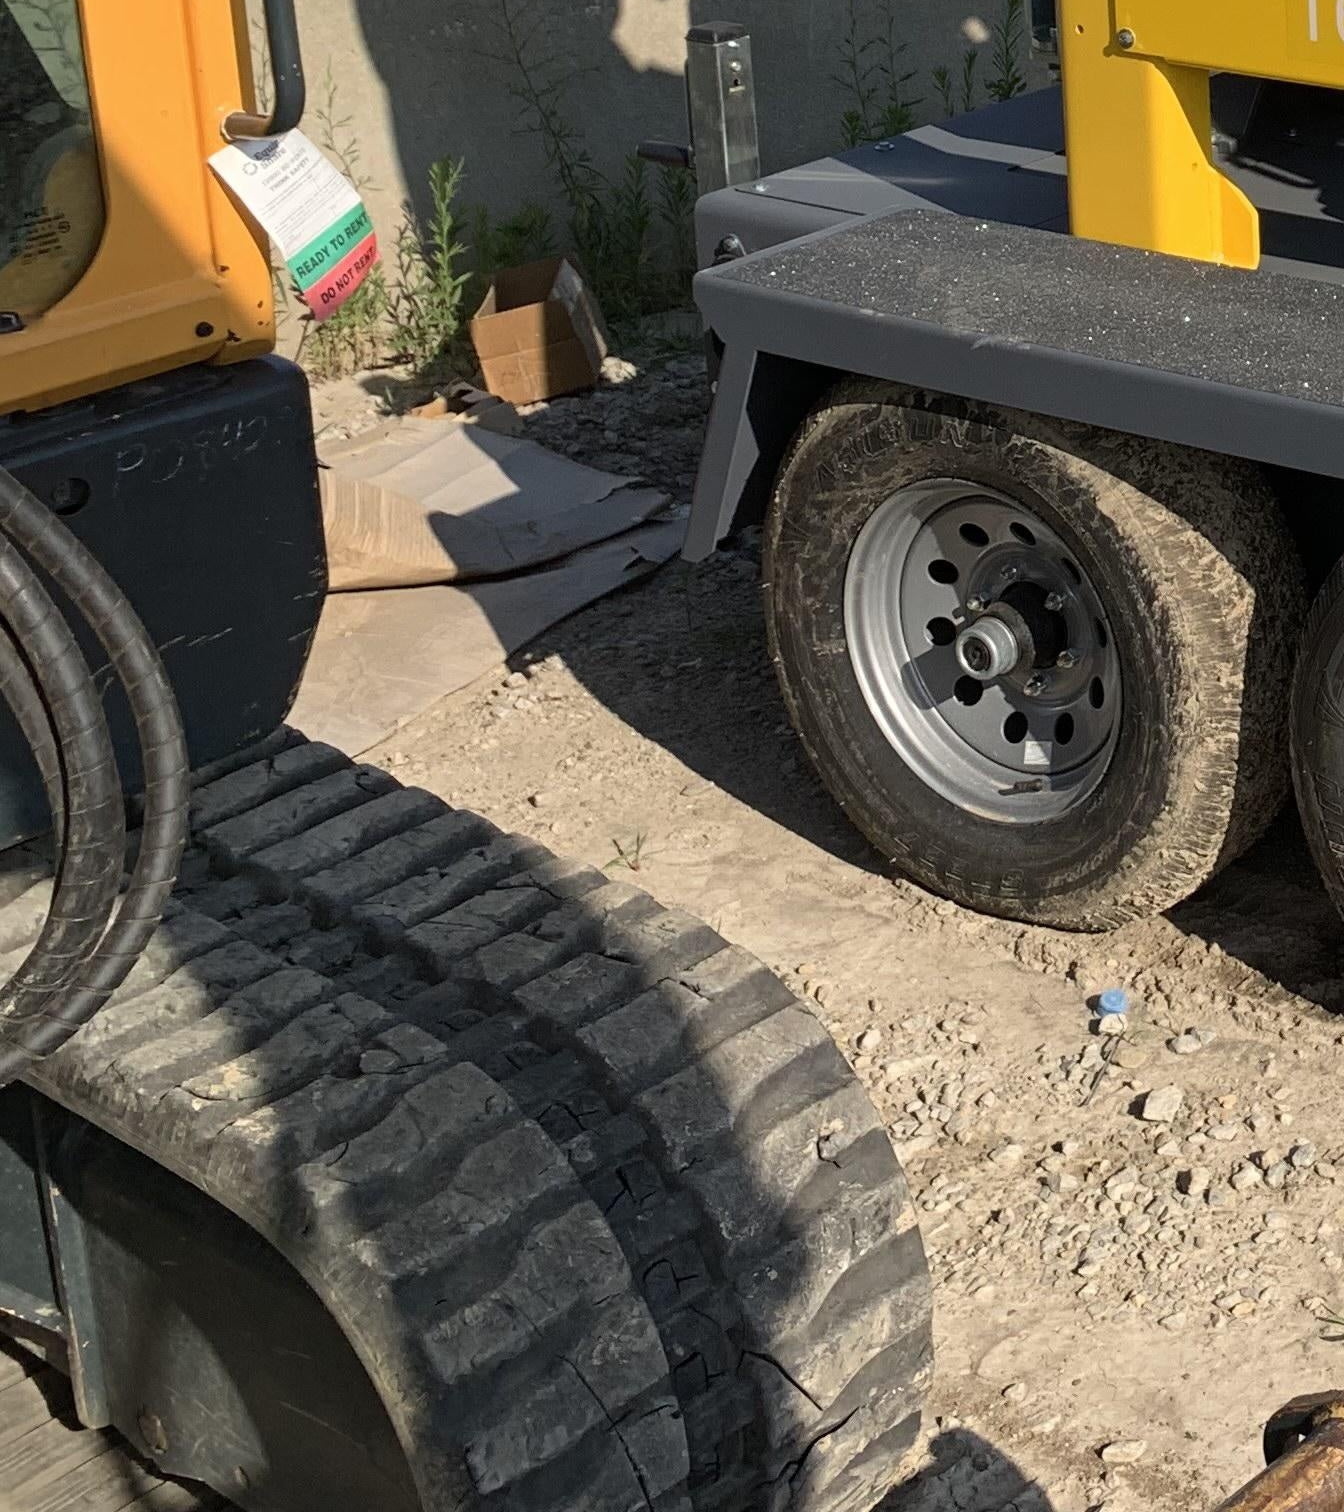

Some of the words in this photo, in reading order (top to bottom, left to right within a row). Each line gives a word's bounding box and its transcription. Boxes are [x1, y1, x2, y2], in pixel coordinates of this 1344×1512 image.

[295, 246, 332, 279] READY
[331, 233, 346, 251] TO
[345, 211, 369, 240] RENT
[320, 288, 337, 306] DO
[336, 268, 356, 292] NOT
[355, 245, 377, 275] RENT
